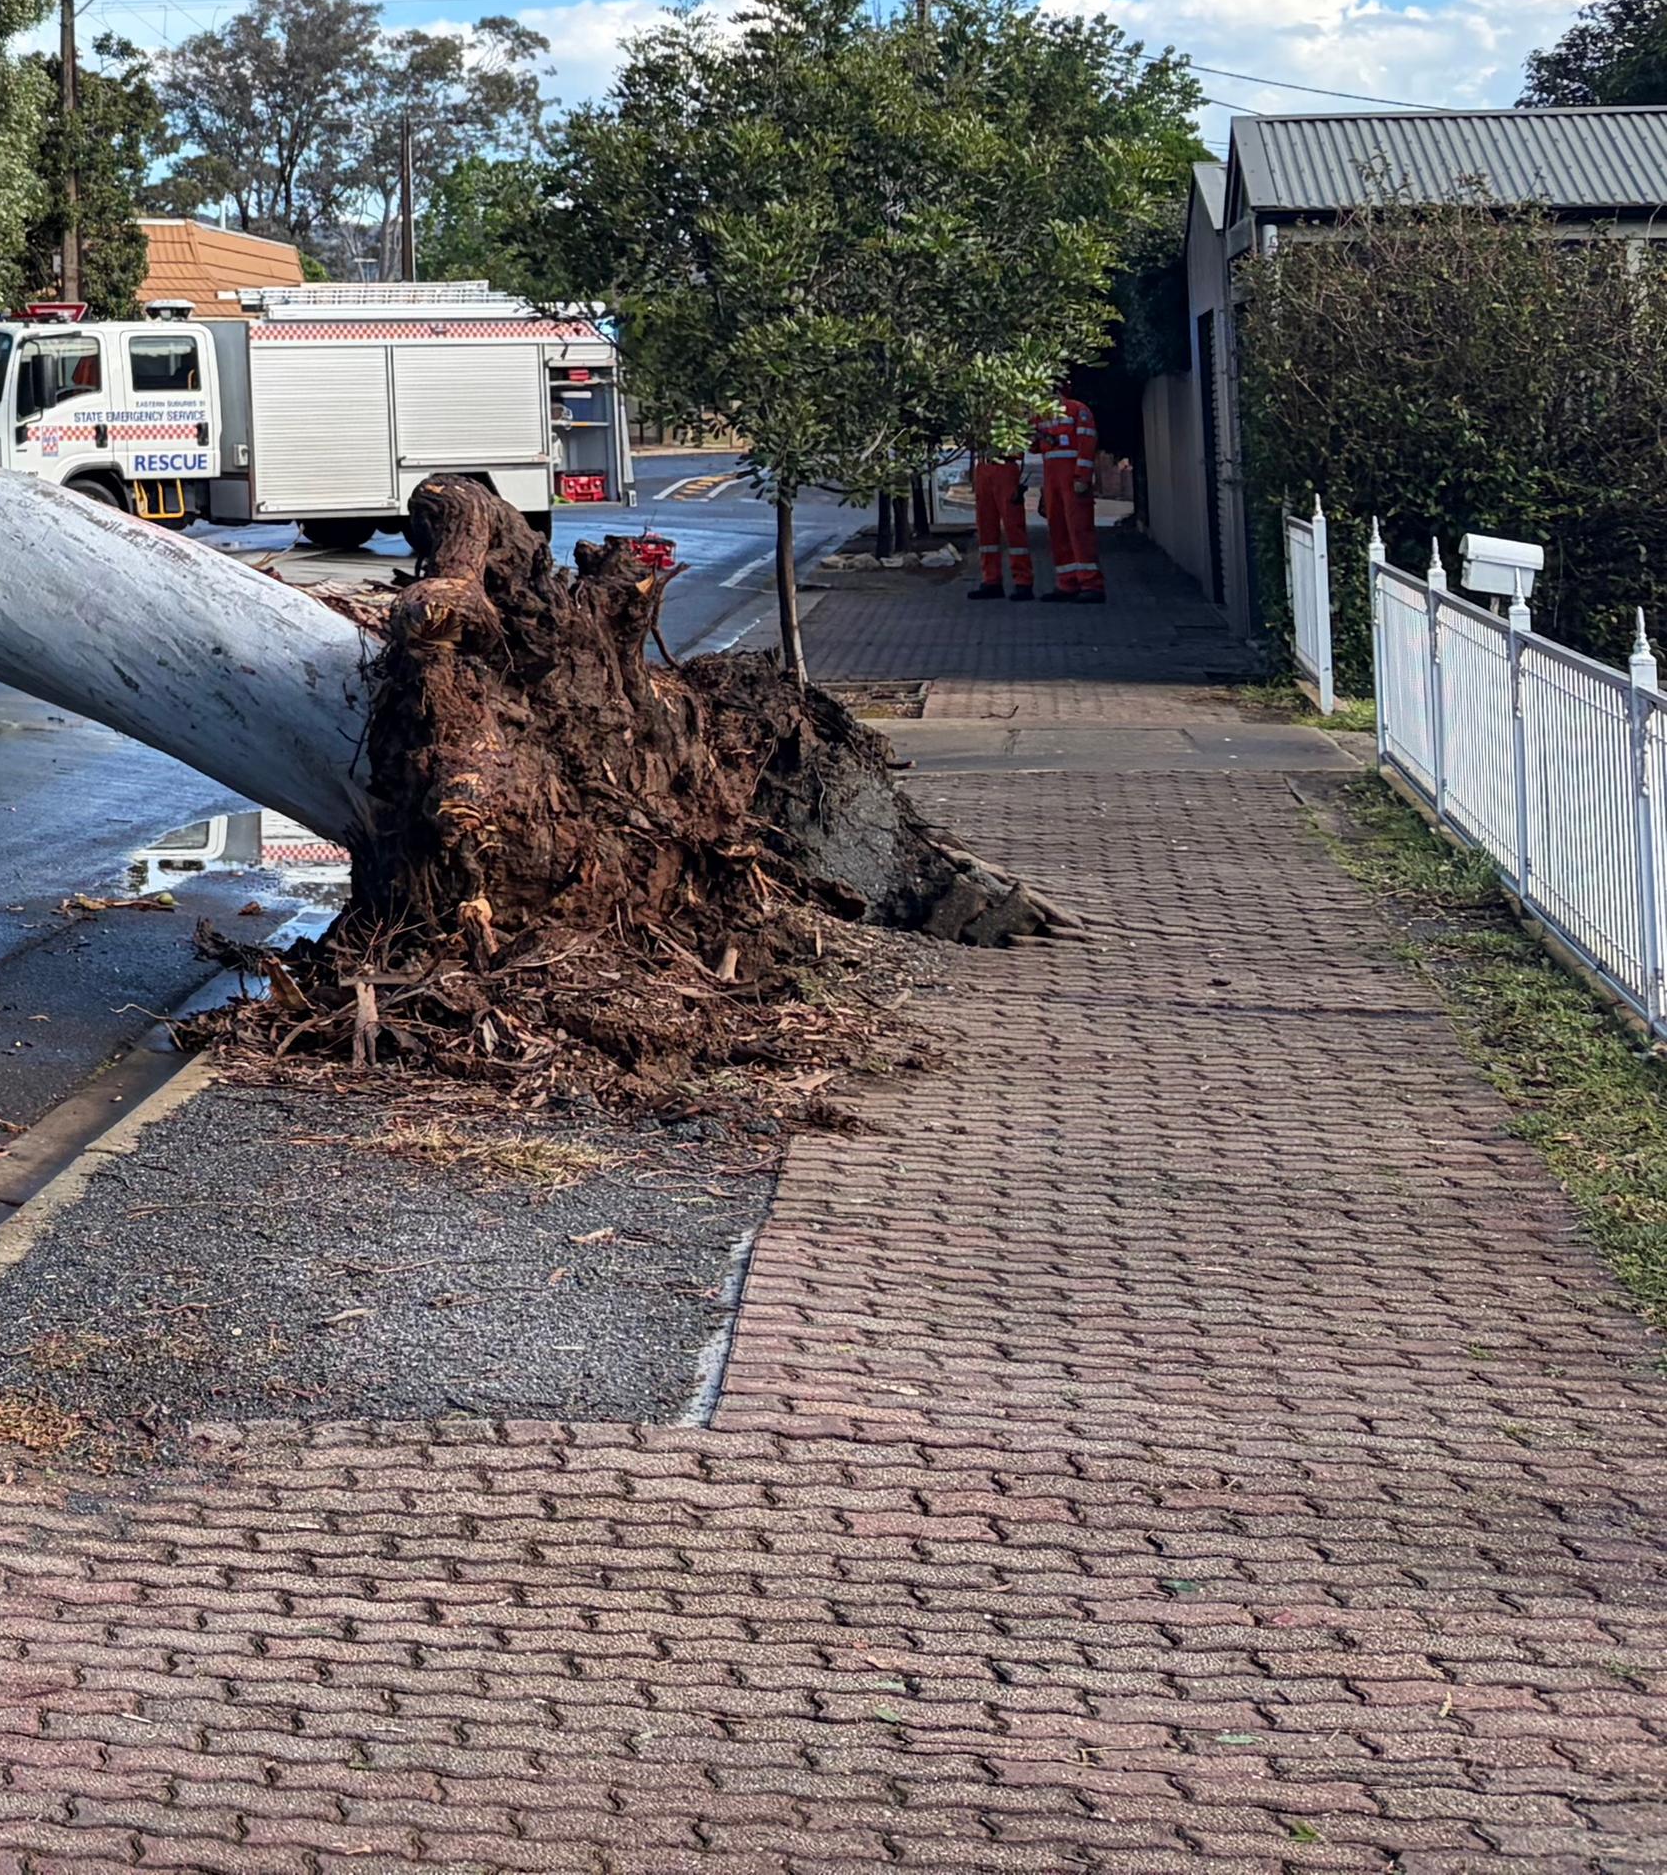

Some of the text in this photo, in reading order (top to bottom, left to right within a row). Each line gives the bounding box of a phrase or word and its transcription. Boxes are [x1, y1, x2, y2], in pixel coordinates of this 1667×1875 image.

[74, 410, 206, 423] STATE EMERGENCY SERVICE
[134, 453, 208, 472] RESCUE
